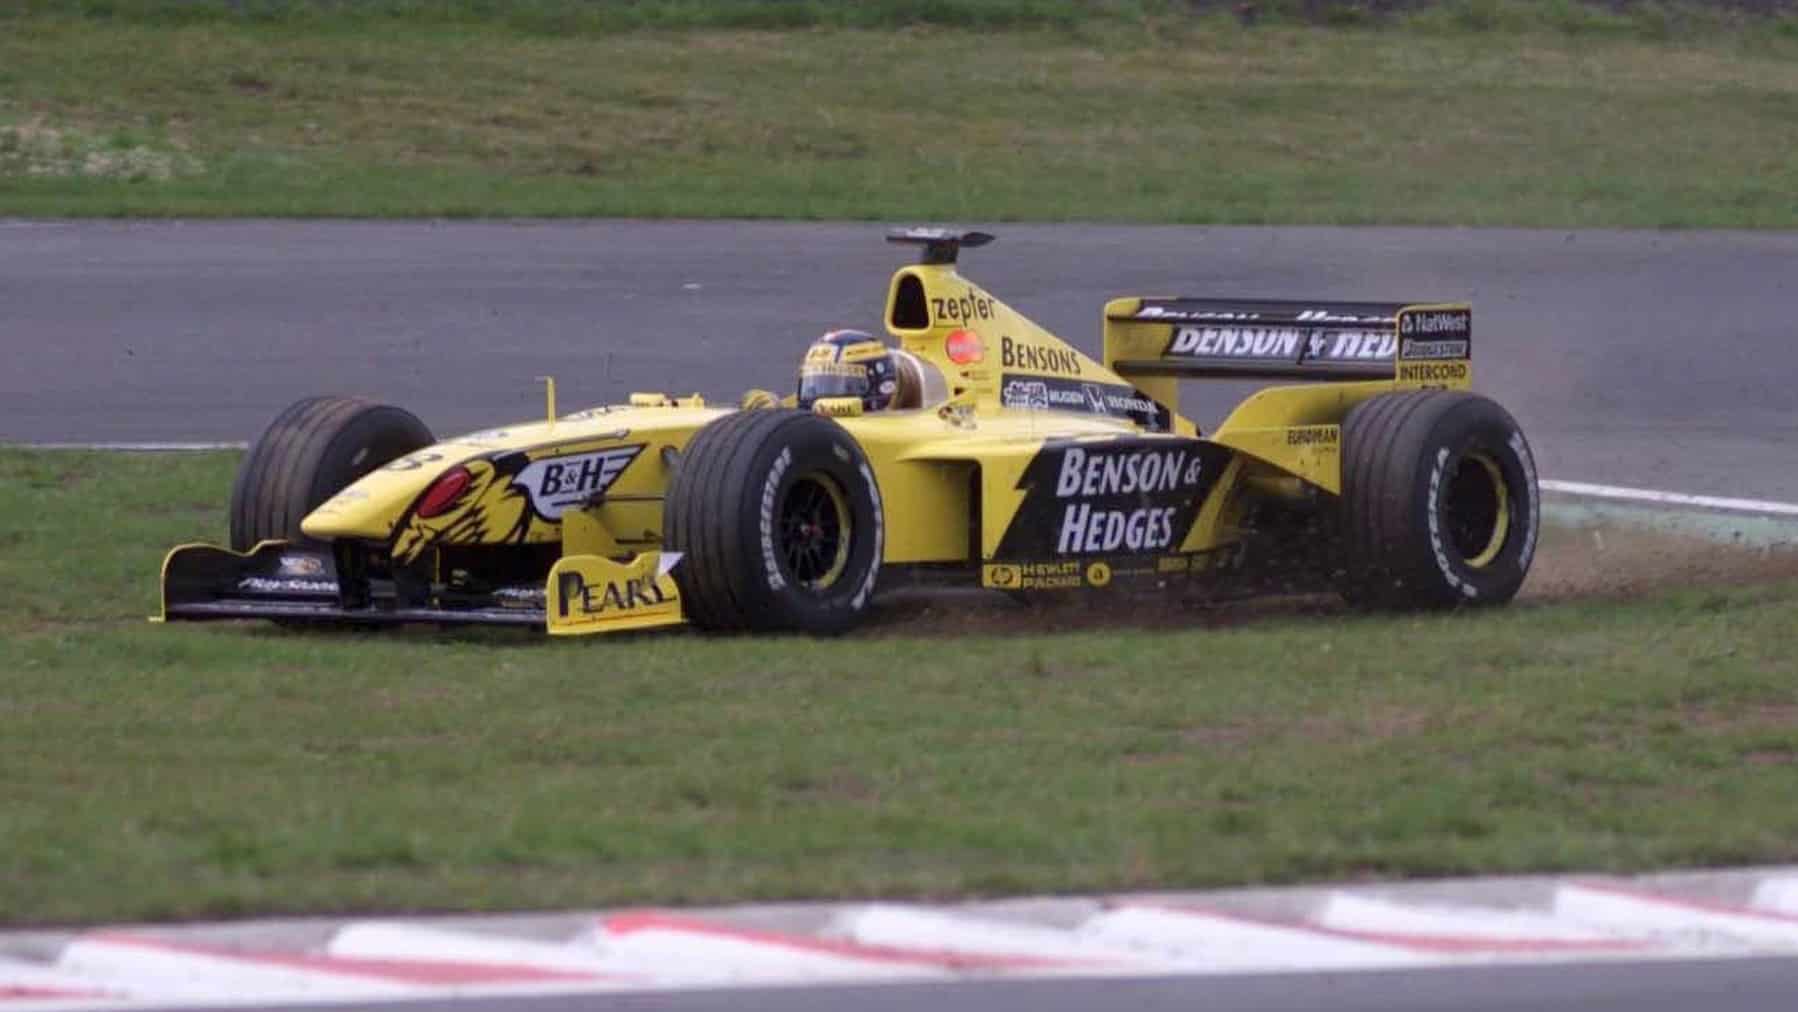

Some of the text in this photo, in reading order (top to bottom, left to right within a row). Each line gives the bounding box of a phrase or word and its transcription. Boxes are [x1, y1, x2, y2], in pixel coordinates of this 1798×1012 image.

[1001, 336, 1081, 375] BENSONS
[1057, 447, 1201, 497] BENSON &
[1057, 503, 1176, 554] HEDGES
[557, 570, 677, 619] PEARL
